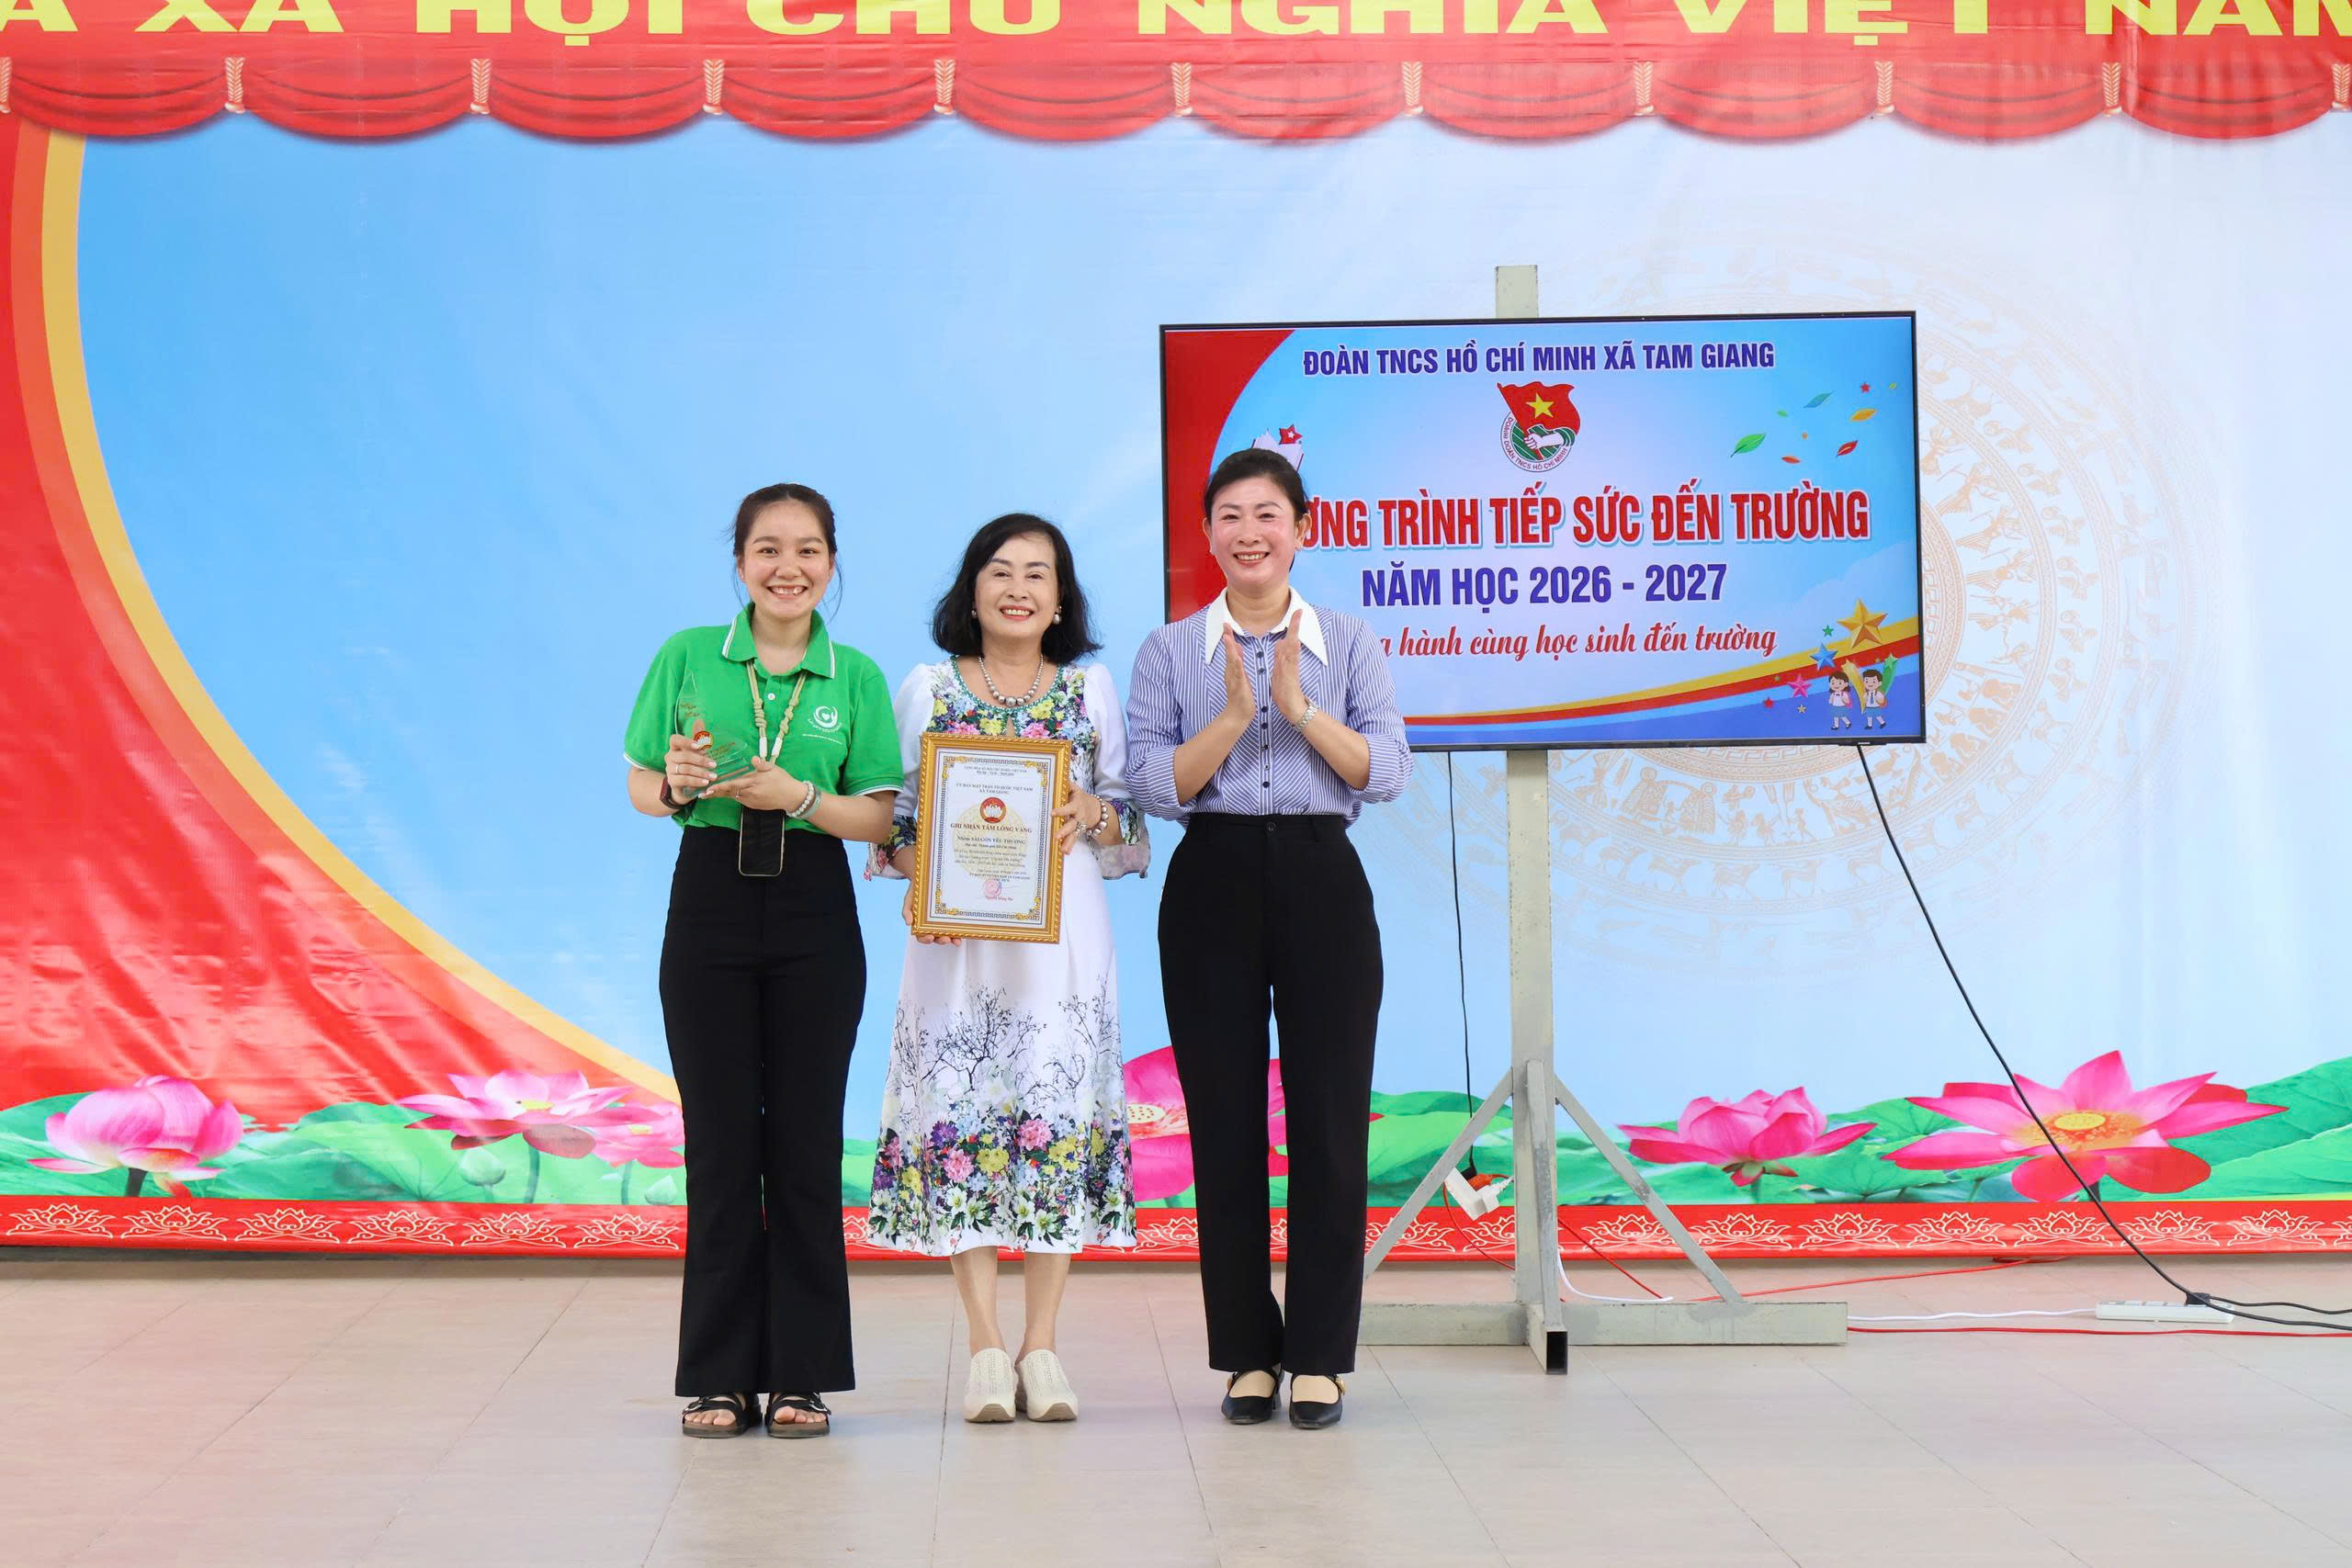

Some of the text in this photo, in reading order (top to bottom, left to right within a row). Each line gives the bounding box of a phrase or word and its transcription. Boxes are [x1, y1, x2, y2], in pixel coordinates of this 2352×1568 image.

[2085, 0, 2352, 35] NA
[1304, 340, 1774, 375] ĐOÀN TNCS HỒ CHÍ MINH XÃ TAM GIANG
[1378, 489, 1479, 547] TRÌNH
[1489, 481, 1563, 544] TIẾP
[1573, 485, 1640, 543] SỨC
[1651, 479, 1721, 541] ĐẾN
[1731, 480, 1870, 539] TRƯỜNG
[1363, 560, 1727, 614] NĂM HỌC 2026 - 2027
[1399, 626, 1464, 657] hành
[1470, 628, 1530, 662] cùng
[1535, 625, 1578, 661] học
[1585, 622, 1638, 654] sinh
[1644, 622, 1690, 653] đến
[1695, 624, 1778, 657] trường
